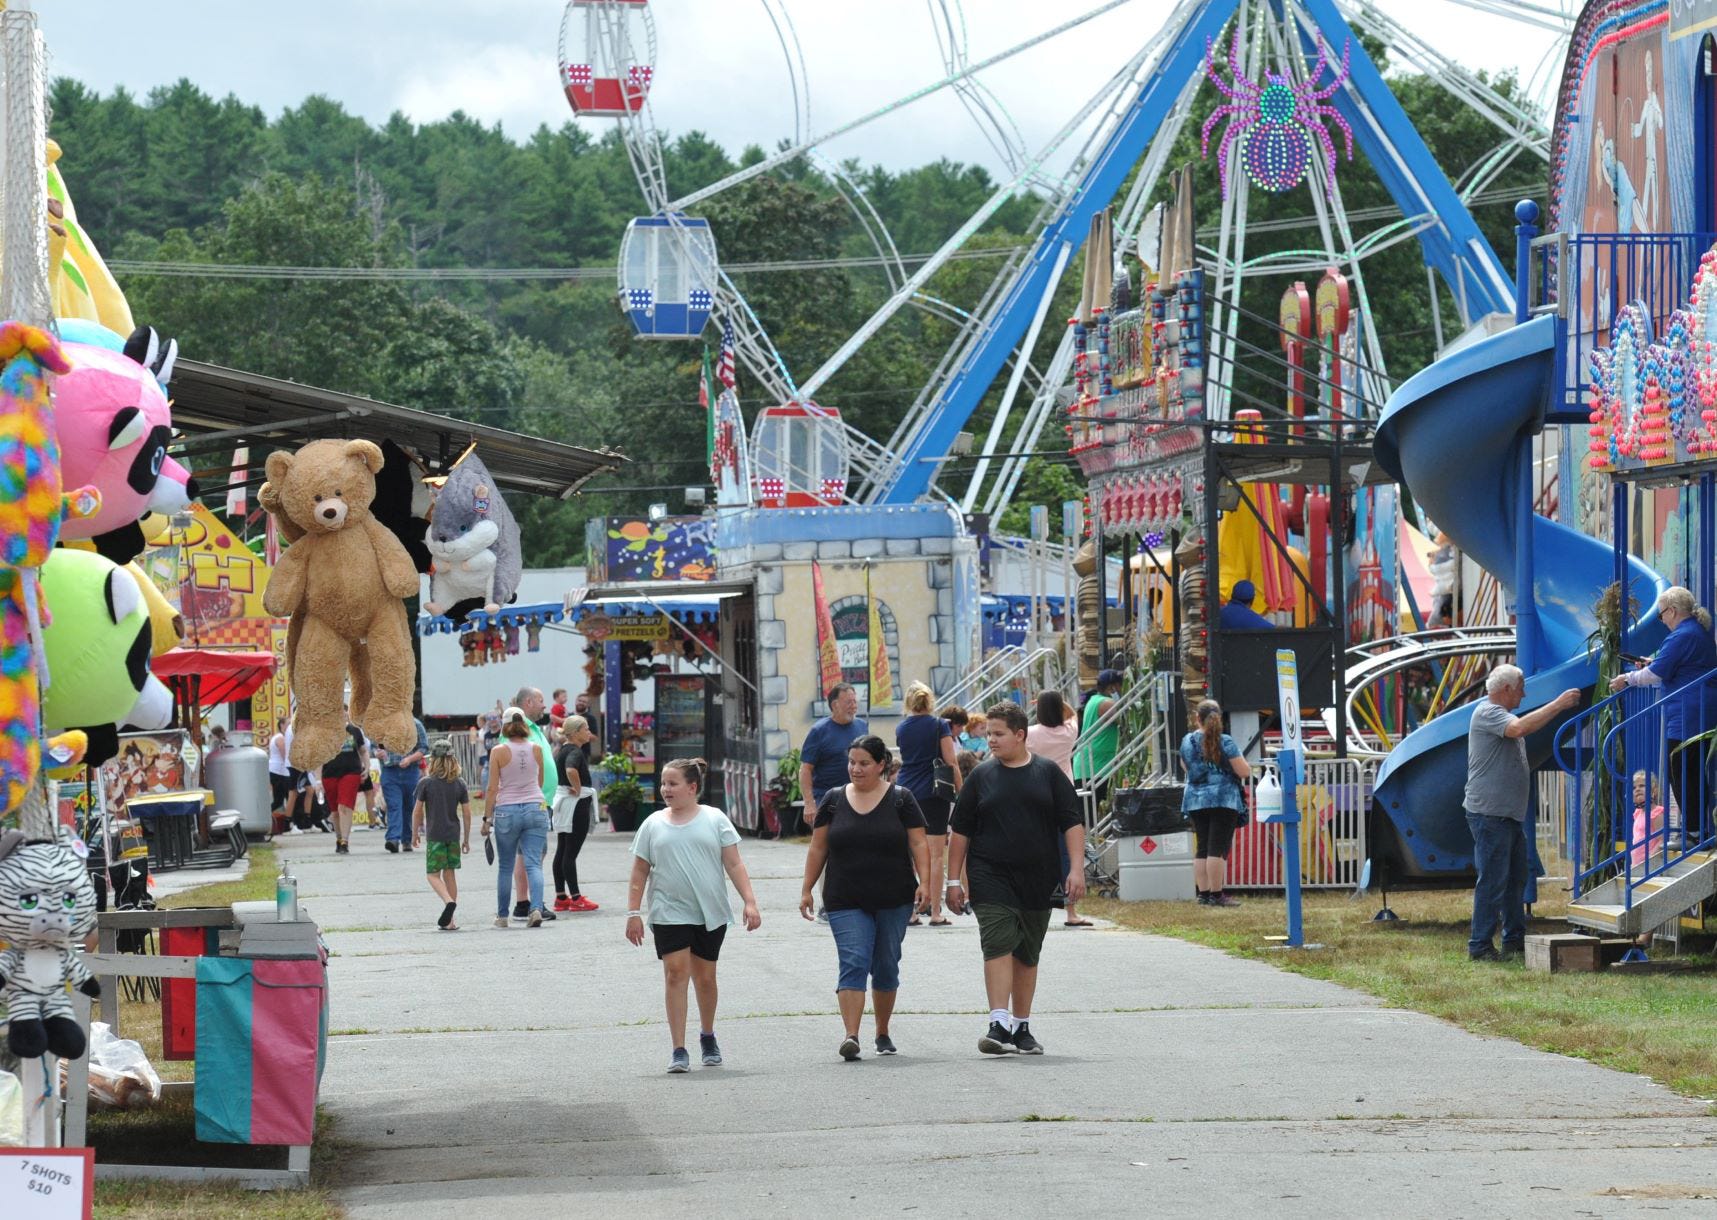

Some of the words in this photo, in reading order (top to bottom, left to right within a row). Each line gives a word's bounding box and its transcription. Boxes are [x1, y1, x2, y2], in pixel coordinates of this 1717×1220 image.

[20, 1160, 29, 1170] 7
[30, 1164, 72, 1186] SHOTS
[27, 1178, 53, 1196] $10
